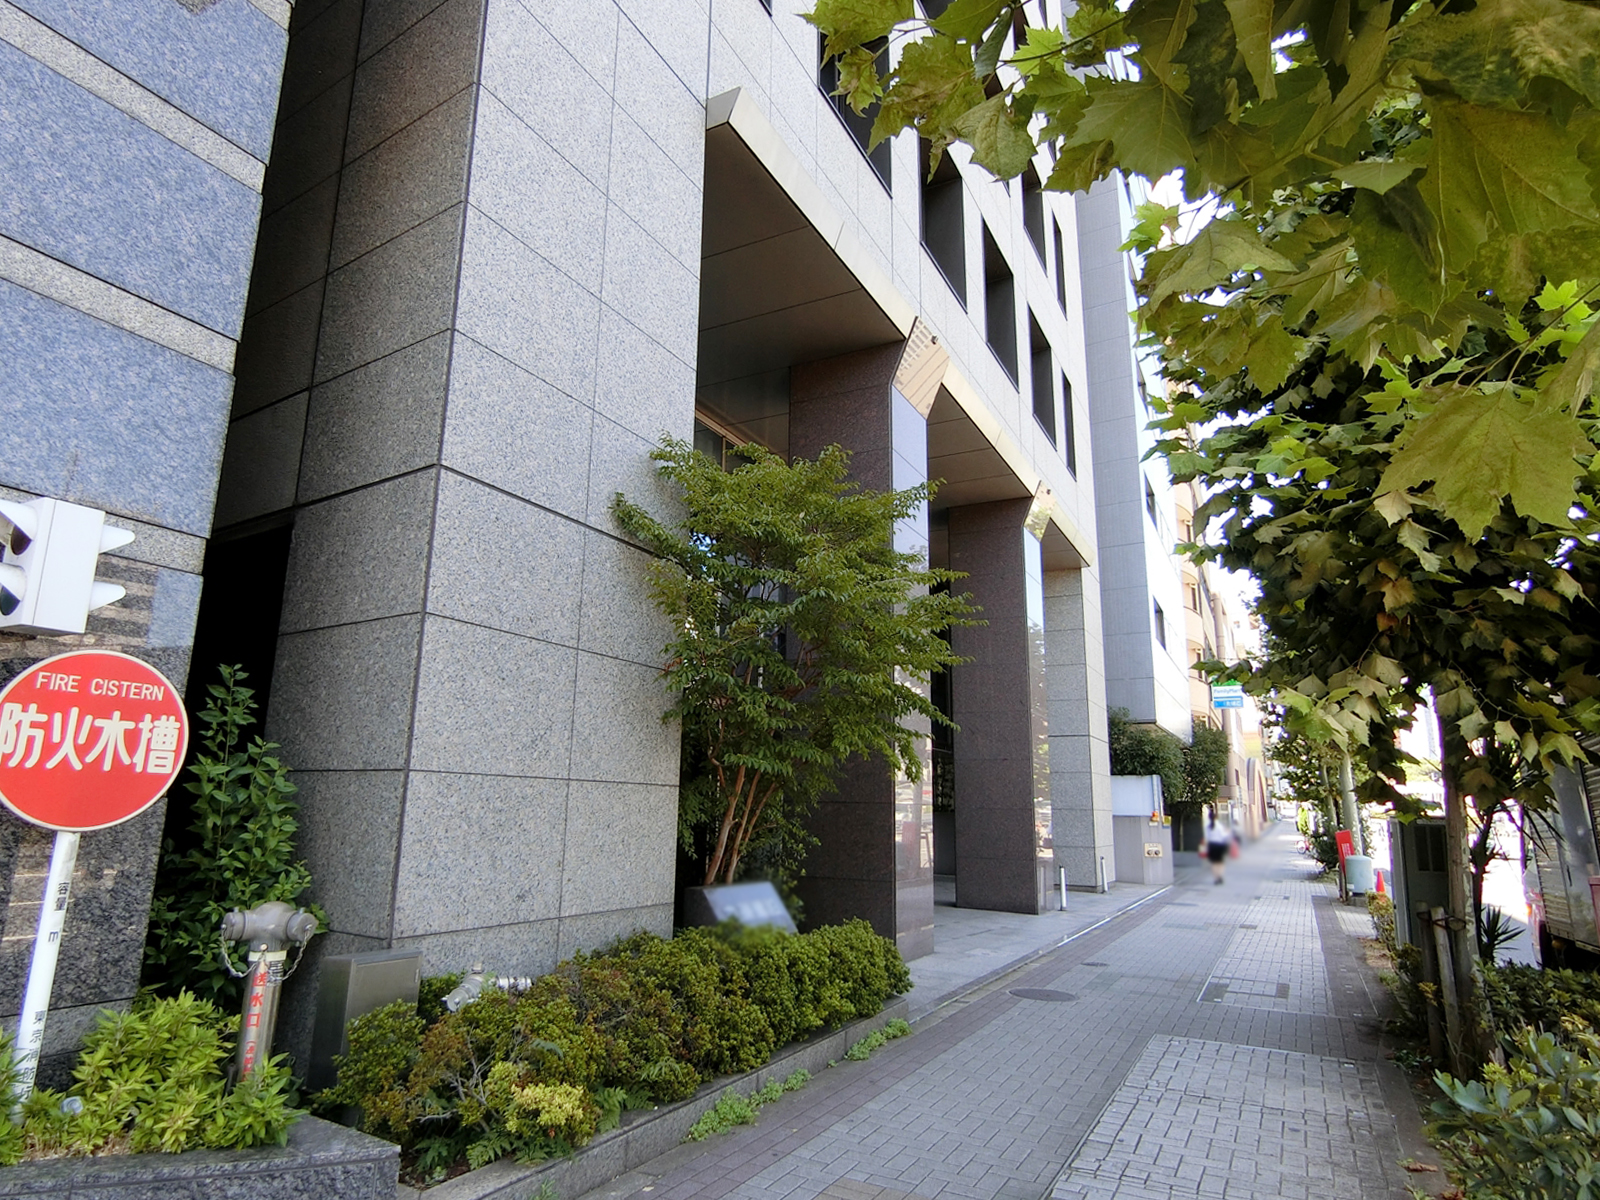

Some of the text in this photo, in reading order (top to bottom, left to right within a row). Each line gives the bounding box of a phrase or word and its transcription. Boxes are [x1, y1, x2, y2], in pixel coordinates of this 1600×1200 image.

[36, 671, 165, 701] FIRE CISTERN
[245, 972, 268, 1028] 送水口
